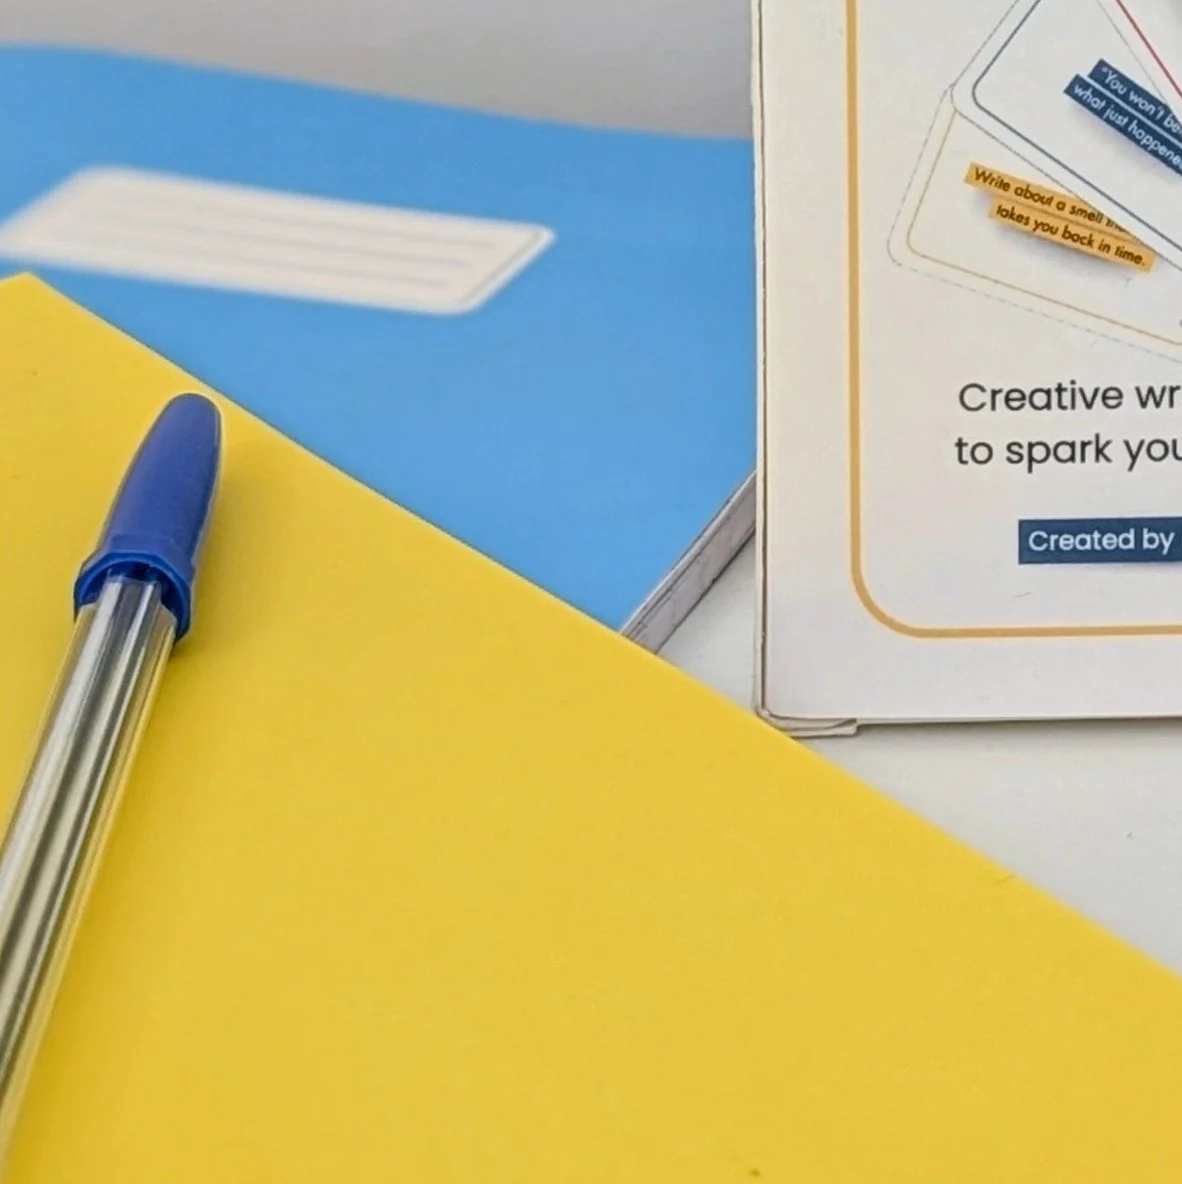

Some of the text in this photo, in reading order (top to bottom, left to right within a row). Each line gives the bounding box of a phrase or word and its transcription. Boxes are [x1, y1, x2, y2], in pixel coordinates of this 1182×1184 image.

[1073, 84, 1107, 110] what
[1102, 104, 1129, 127] just
[1129, 90, 1164, 121] won't
[974, 167, 1104, 224] Write about a smell
[996, 204, 1031, 226] takes
[1032, 219, 1059, 236] you
[1061, 224, 1094, 248] back
[1098, 239, 1111, 254] in
[1114, 244, 1146, 266] time.
[958, 381, 1124, 412] Creative
[954, 434, 994, 465] to
[1004, 433, 1113, 473] spark
[1028, 527, 1135, 552] Created
[1142, 527, 1175, 555] by
